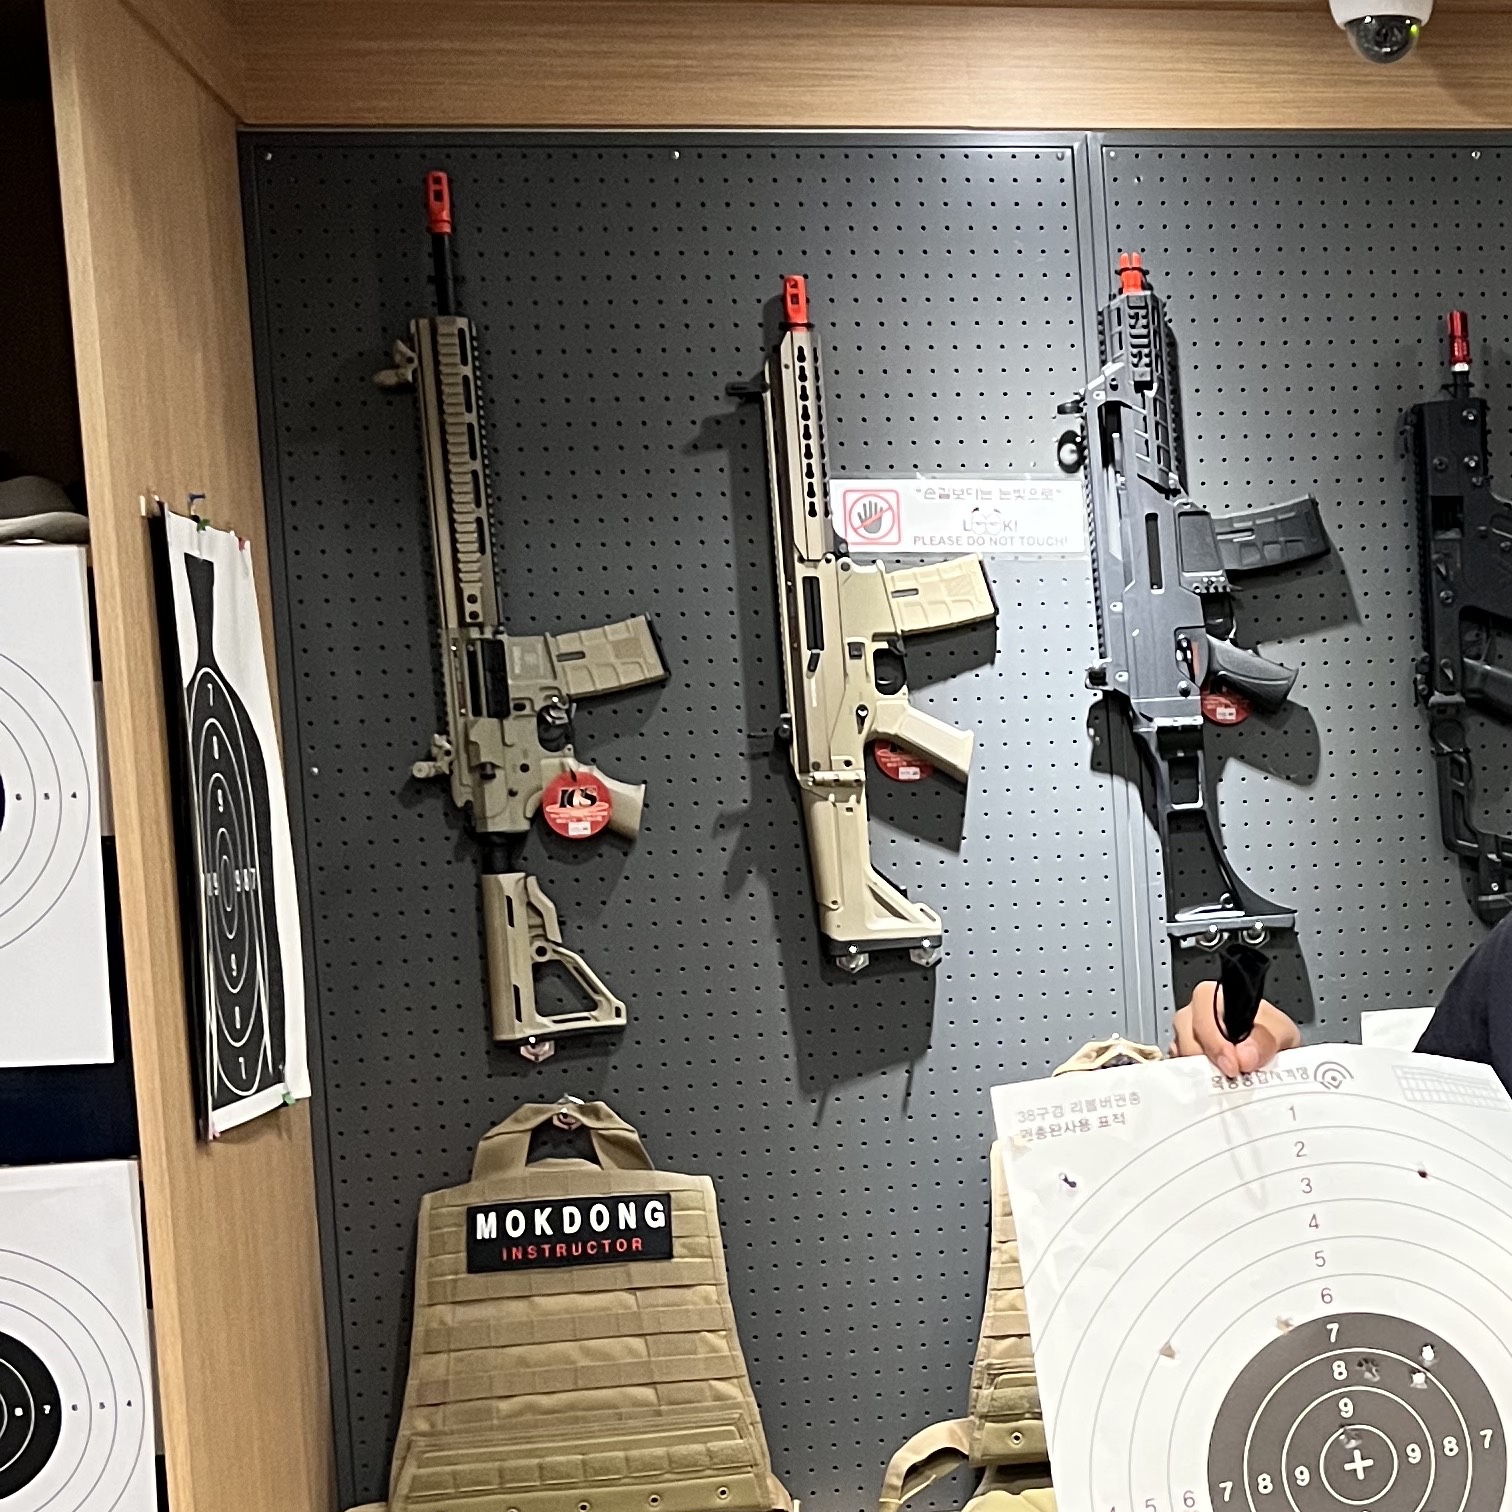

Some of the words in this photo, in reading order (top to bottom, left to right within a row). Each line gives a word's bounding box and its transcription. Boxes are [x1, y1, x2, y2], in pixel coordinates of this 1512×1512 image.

[913, 536, 963, 546] PLEASE
[967, 536, 986, 546] DO
[989, 536, 1018, 547] NOT
[1020, 536, 1068, 547] TOUCH!
[1288, 1106, 1296, 1121] 1
[1295, 1141, 1306, 1157] 2
[1301, 1177, 1312, 1193] 3
[476, 1199, 666, 1240] MOKDONG
[1308, 1214, 1319, 1229] 4
[502, 1237, 644, 1261] INSTRUCTOR
[1315, 1251, 1326, 1267] 5
[1321, 1288, 1333, 1304] 6
[1327, 1322, 1340, 1343] 7
[1332, 1361, 1348, 1381] 8
[1338, 1397, 1355, 1419] 9
[1405, 1443, 1422, 1463] 9
[1442, 1436, 1458, 1457] 8
[1480, 1428, 1493, 1449] 7
[1183, 1491, 1195, 1508] 6
[1219, 1480, 1233, 1501] 7
[1257, 1473, 1273, 1495] 8
[1294, 1466, 1311, 1487] 9
